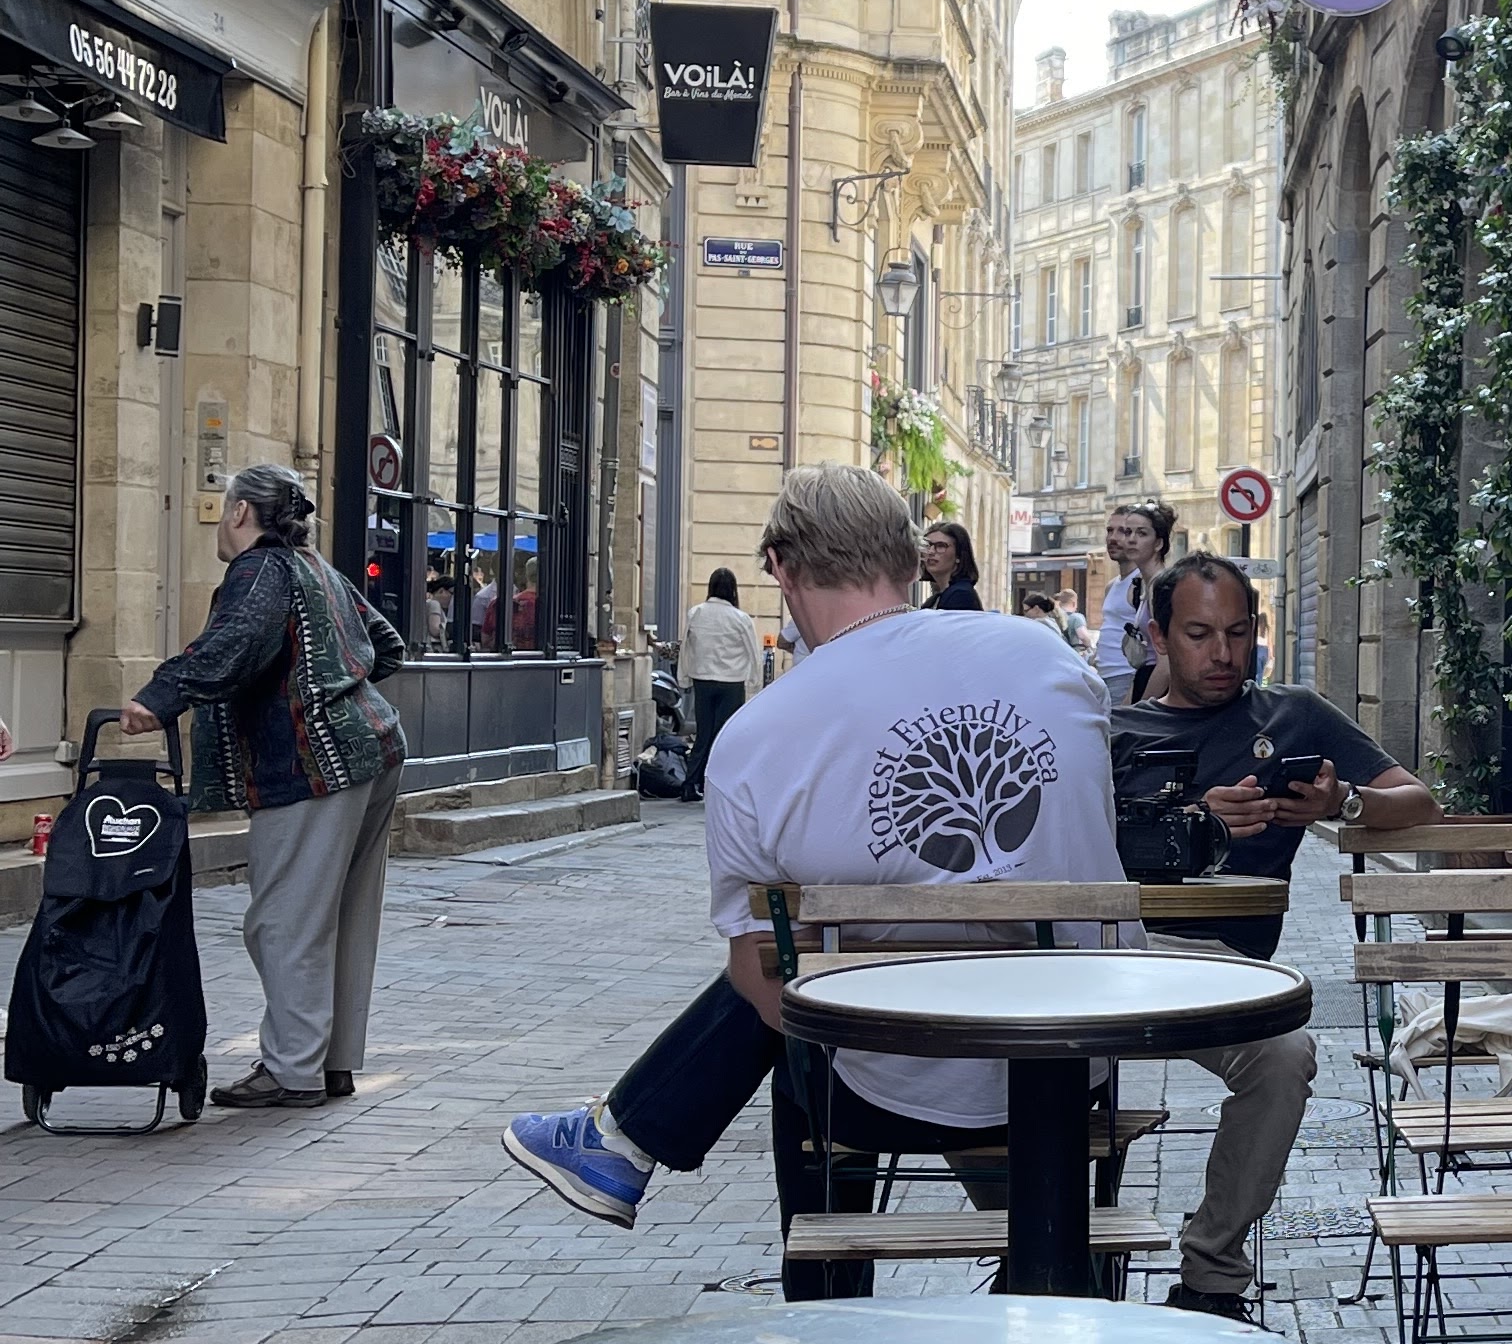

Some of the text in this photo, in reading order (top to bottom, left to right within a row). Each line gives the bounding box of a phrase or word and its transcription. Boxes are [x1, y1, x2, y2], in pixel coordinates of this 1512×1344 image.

[69, 23, 177, 110] 05 56 44 72 28
[734, 242, 754, 251] RUE
[867, 699, 1059, 863] Forest Friendly Tea
[993, 863, 1013, 877] 2013
[552, 1117, 580, 1149] N
